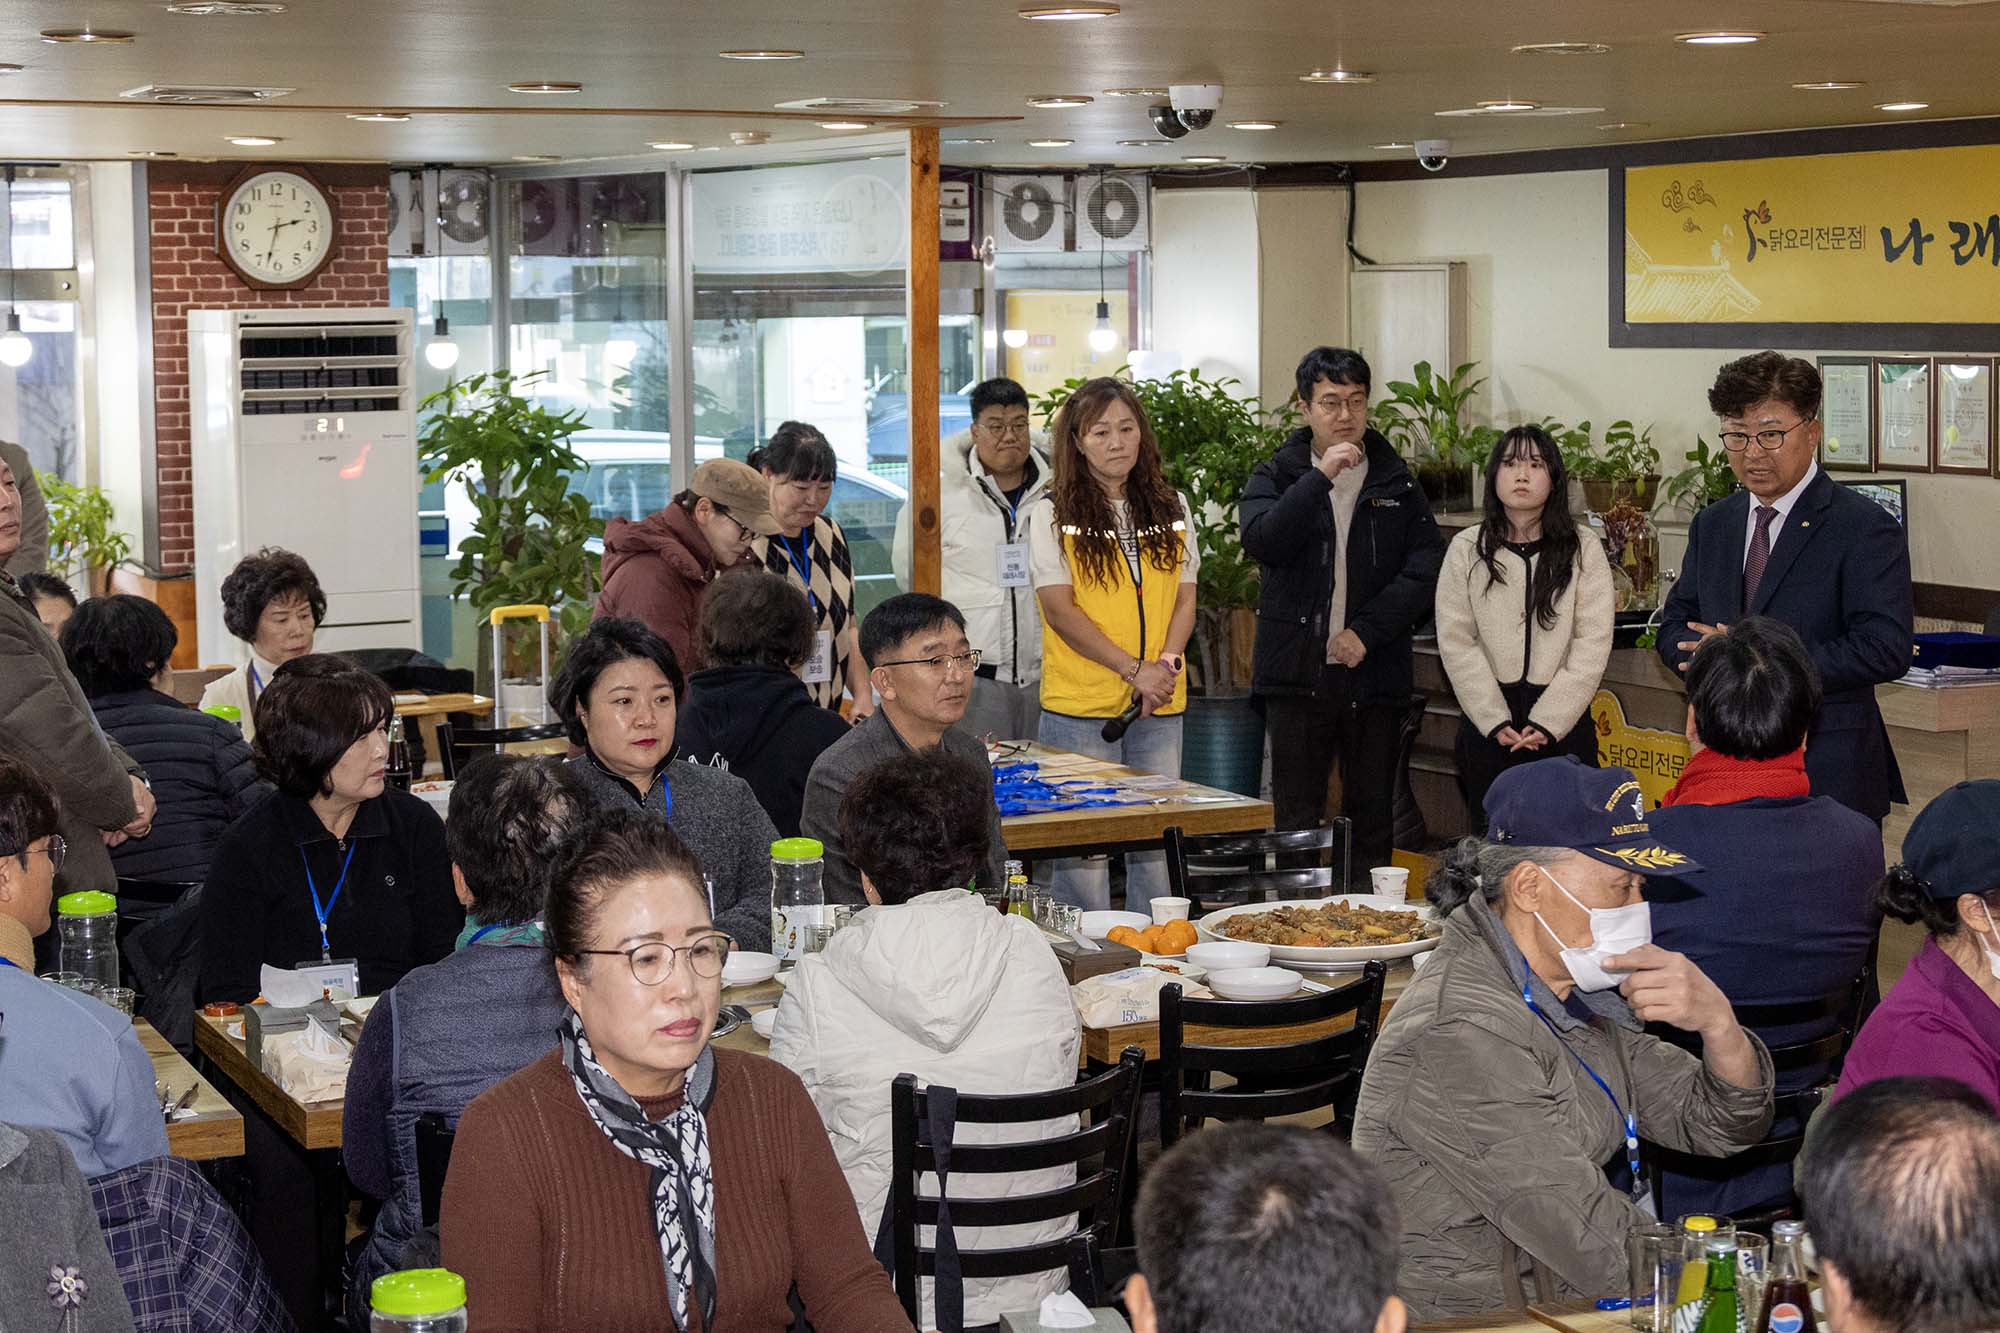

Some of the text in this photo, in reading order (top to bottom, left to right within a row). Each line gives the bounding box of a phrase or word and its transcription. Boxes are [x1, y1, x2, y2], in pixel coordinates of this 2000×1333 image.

[251, 187, 262, 201] 11
[269, 183, 283, 197] 12
[291, 188, 297, 201] 1
[238, 202, 252, 216] 10
[303, 200, 312, 214] 2
[235, 221, 246, 233] 9
[308, 220, 318, 234] 3
[240, 238, 250, 252] 8
[1769, 225, 1864, 252] 닭요리전문점
[303, 240, 312, 252] 4
[255, 253, 263, 267] 7
[292, 252, 302, 266] 5
[273, 261, 283, 272] 6
[317, 418, 344, 433] 21
[1610, 743, 1692, 780] 닭요리전문
